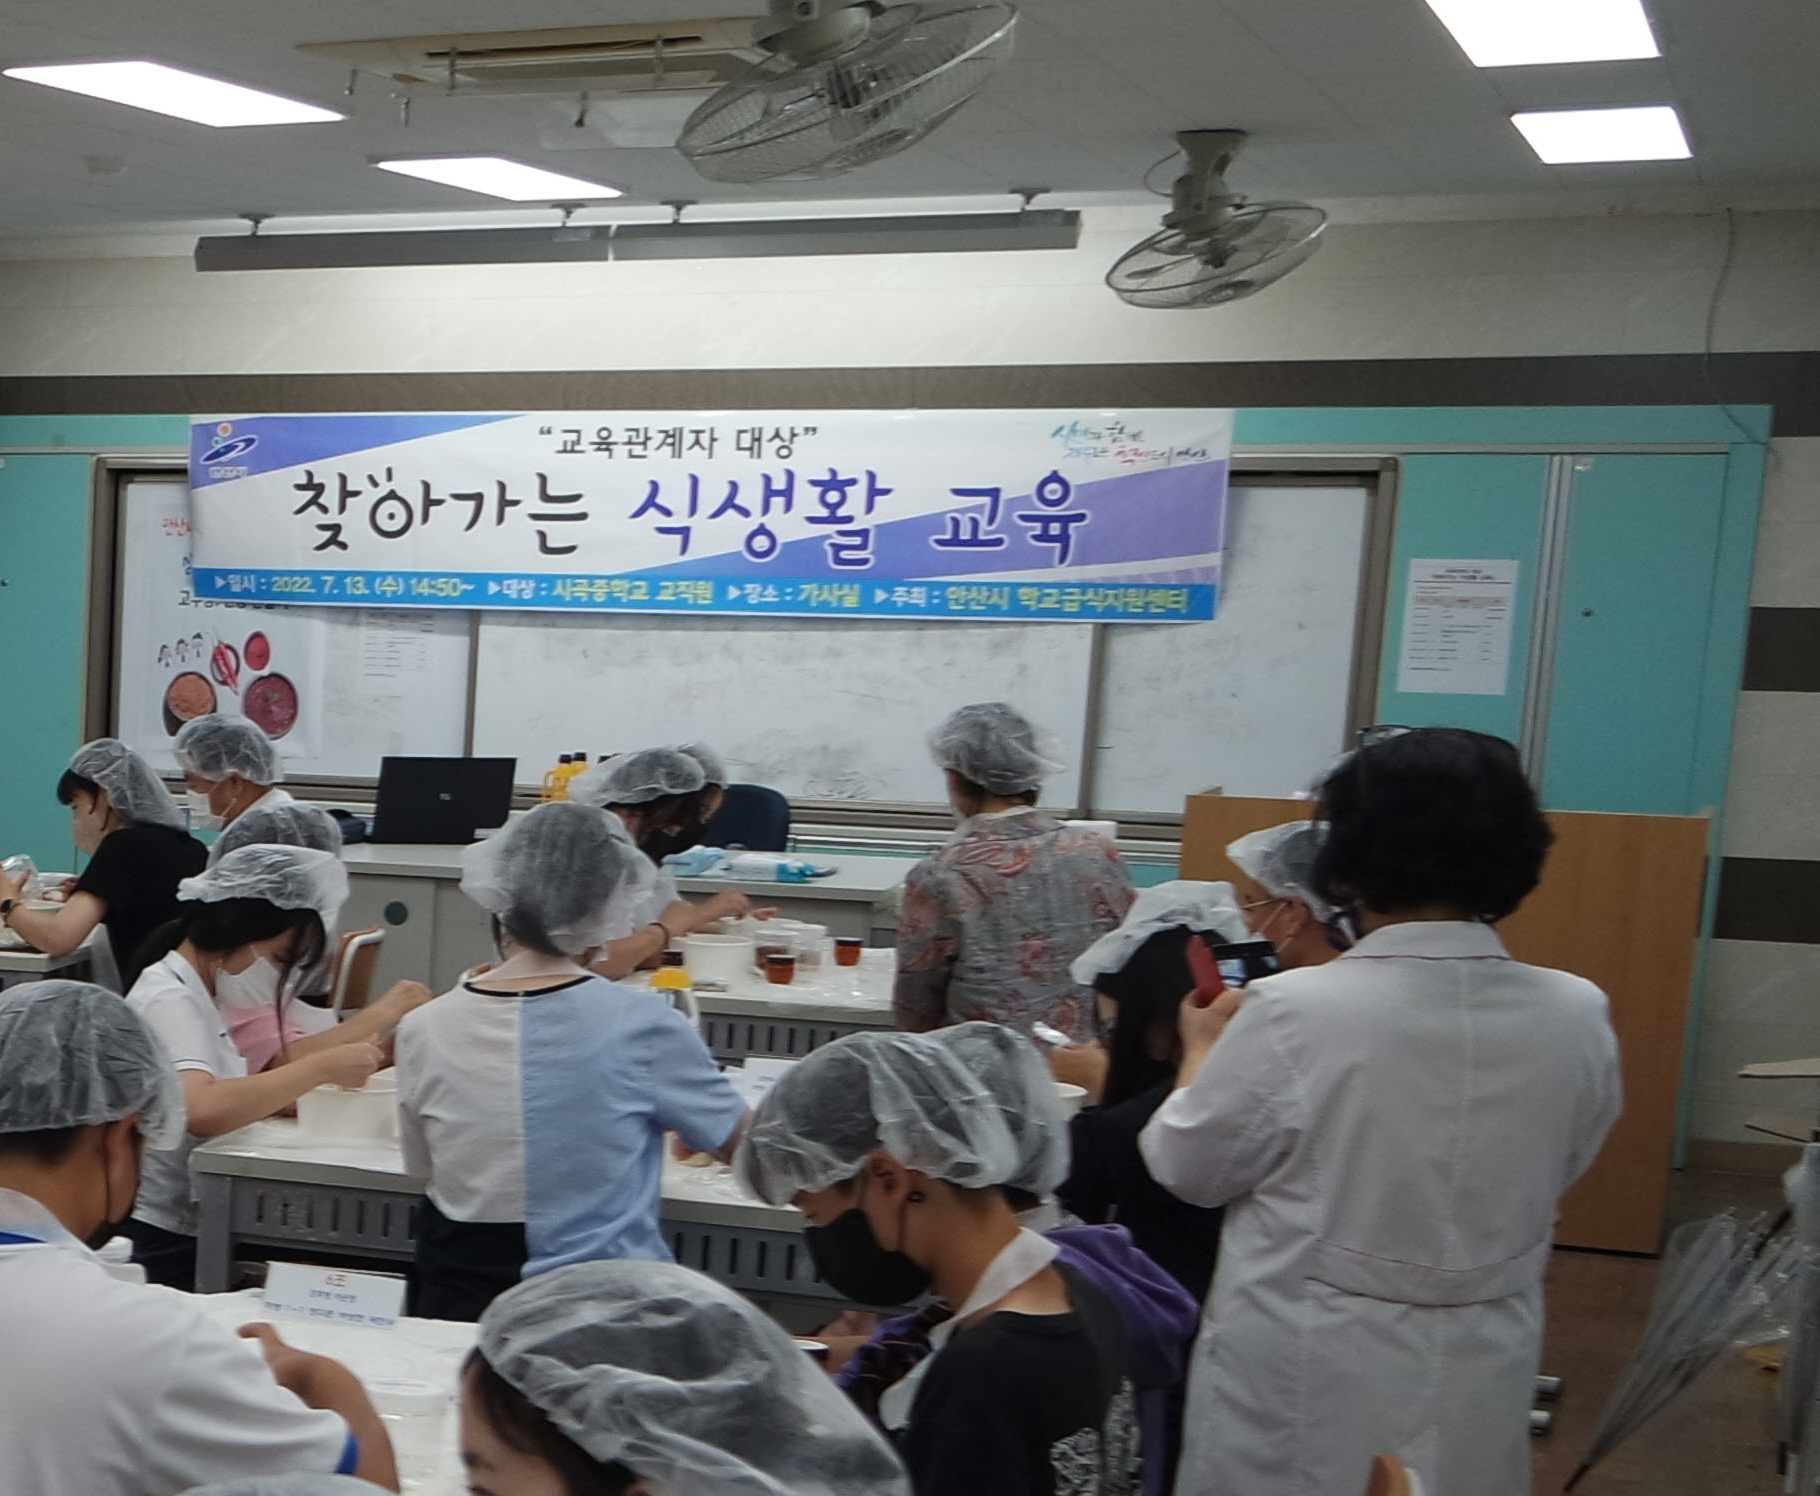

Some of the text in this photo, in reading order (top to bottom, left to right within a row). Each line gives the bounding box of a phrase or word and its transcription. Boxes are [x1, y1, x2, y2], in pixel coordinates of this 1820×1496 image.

[291, 466, 1089, 568] 찾아가는 식생활 교육
[271, 576, 316, 594] 2022.
[320, 577, 339, 594] 7.
[343, 577, 369, 595] 13.
[374, 575, 404, 598] (수)
[502, 579, 536, 600] 대상
[552, 578, 650, 604] 시곡중학교
[654, 581, 715, 605] 교직원
[743, 583, 780, 604] 장소
[798, 582, 861, 608] 가사실
[945, 586, 1009, 611] 안산시
[1017, 587, 1189, 614] 학교급식지원센터
